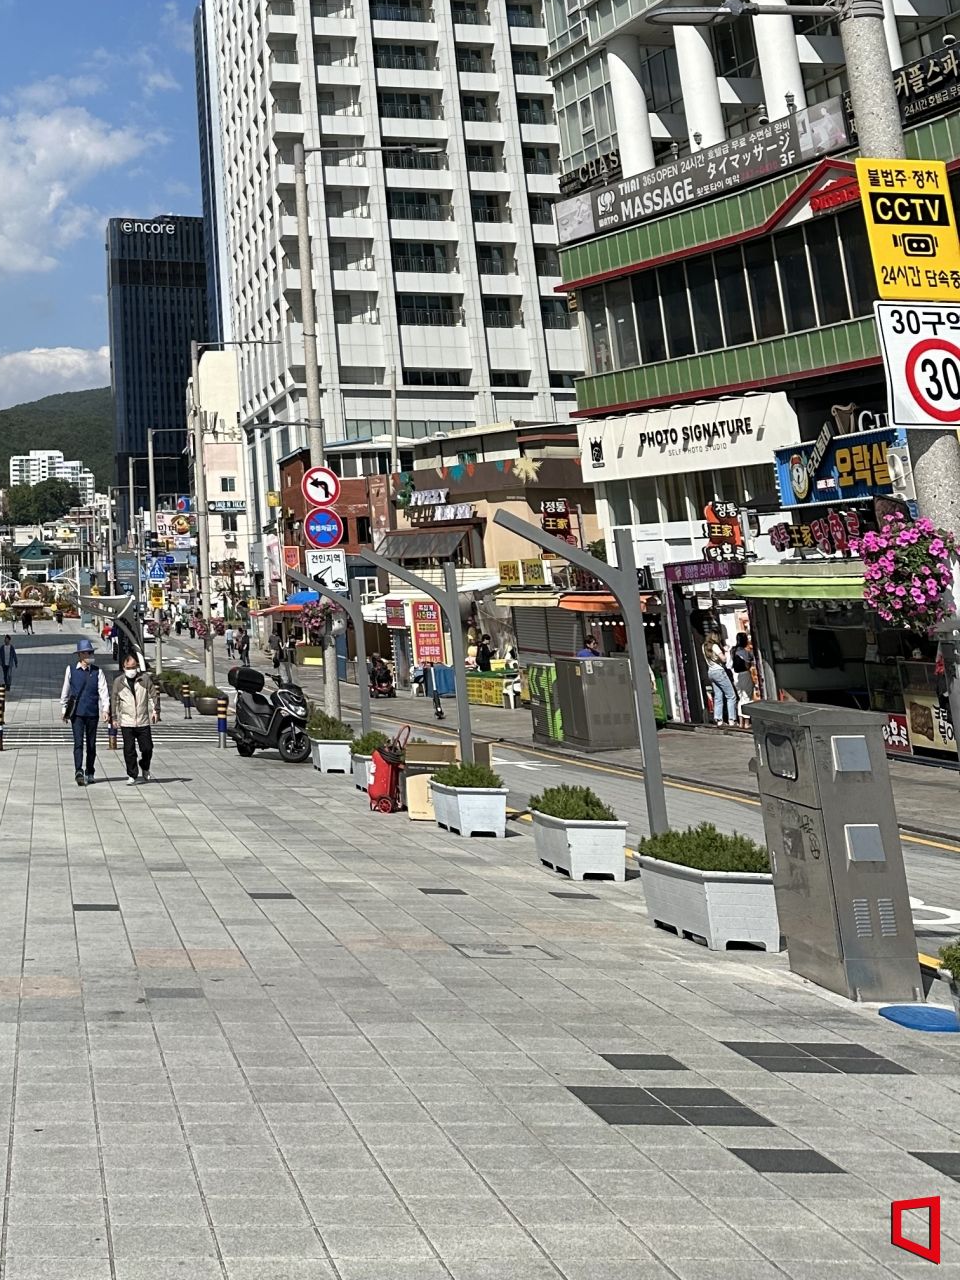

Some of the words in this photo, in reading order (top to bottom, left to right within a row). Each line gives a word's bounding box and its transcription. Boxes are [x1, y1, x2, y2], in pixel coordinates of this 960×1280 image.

[894, 49, 959, 97] 커플스파
[904, 99, 928, 117] 24시간
[642, 172, 657, 188] 365
[656, 166, 679, 183] OPEN
[680, 154, 705, 174] 24시간
[707, 143, 729, 161] 호텔급
[731, 138, 747, 152] 무료
[748, 127, 773, 144] 수면실
[773, 119, 792, 135] 완비
[706, 131, 791, 180] タイマッサージ
[779, 150, 796, 168] 3F
[618, 178, 641, 196] THAI
[725, 174, 741, 188] 예약
[620, 177, 695, 222] MASSAGE
[876, 197, 940, 222] CCTV
[123, 221, 176, 235] encore
[881, 265, 921, 288] 24시간
[925, 270, 960, 290] 단속중
[921, 358, 960, 403] 30
[639, 428, 678, 448] PHOTO
[682, 417, 753, 442] SIGNATURE
[668, 448, 682, 457] SELF
[683, 445, 703, 455] HOTO
[544, 501, 567, 513] 정통
[715, 503, 739, 517] 정통
[544, 517, 569, 530] 王家
[711, 524, 733, 538] 王家
[311, 553, 342, 564] 견인지역
[709, 542, 746, 562] 탕후루
